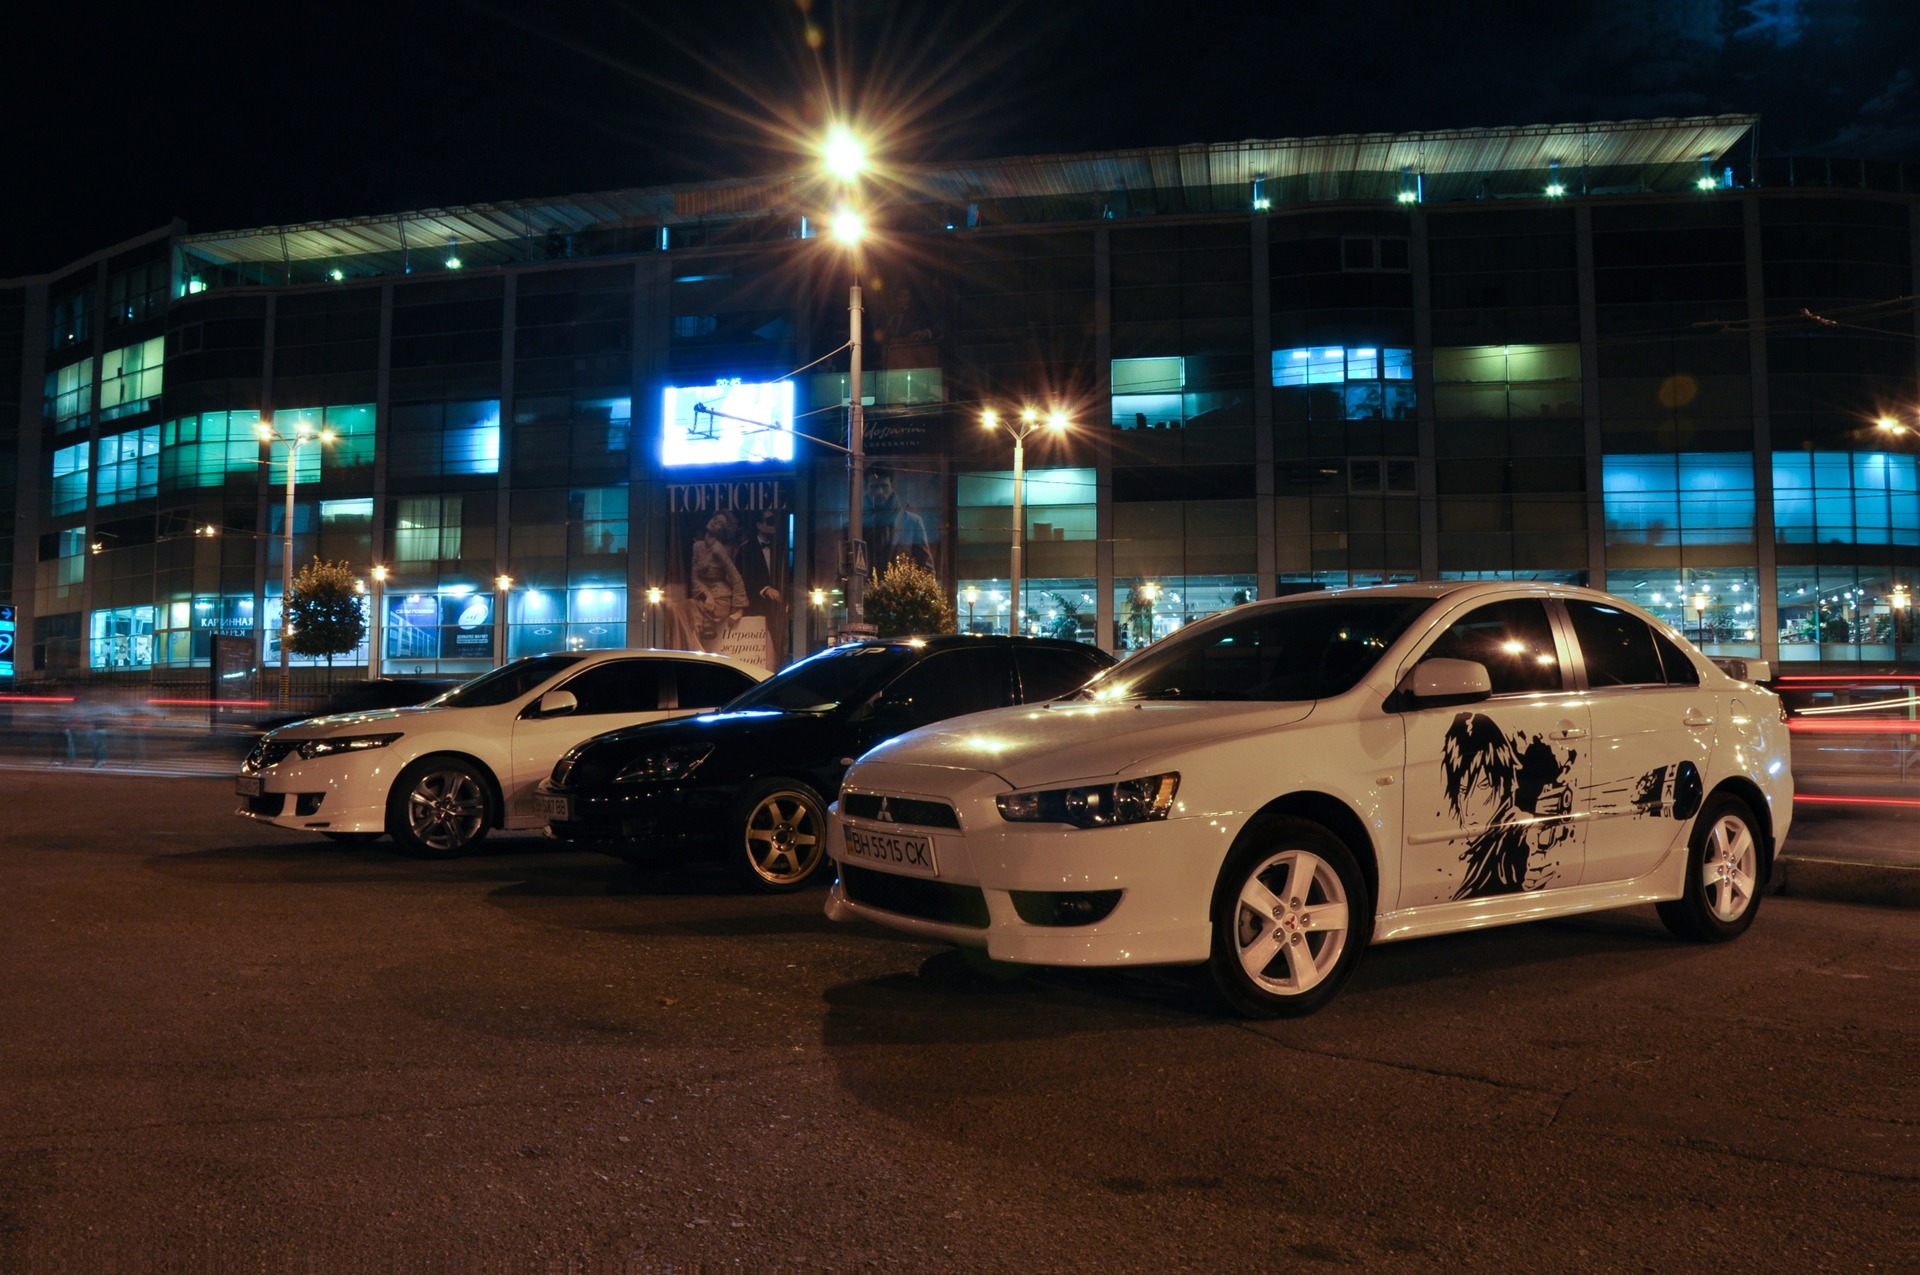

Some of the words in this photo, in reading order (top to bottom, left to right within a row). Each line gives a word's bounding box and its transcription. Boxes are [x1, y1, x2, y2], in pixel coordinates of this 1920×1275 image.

[201, 617, 254, 627] КАРИННАЯ
[722, 629, 766, 641] Первый
[720, 644, 766, 654] журнал
[852, 832, 871, 857] BH
[872, 838, 903, 862] 5515
[905, 842, 928, 866] CK
